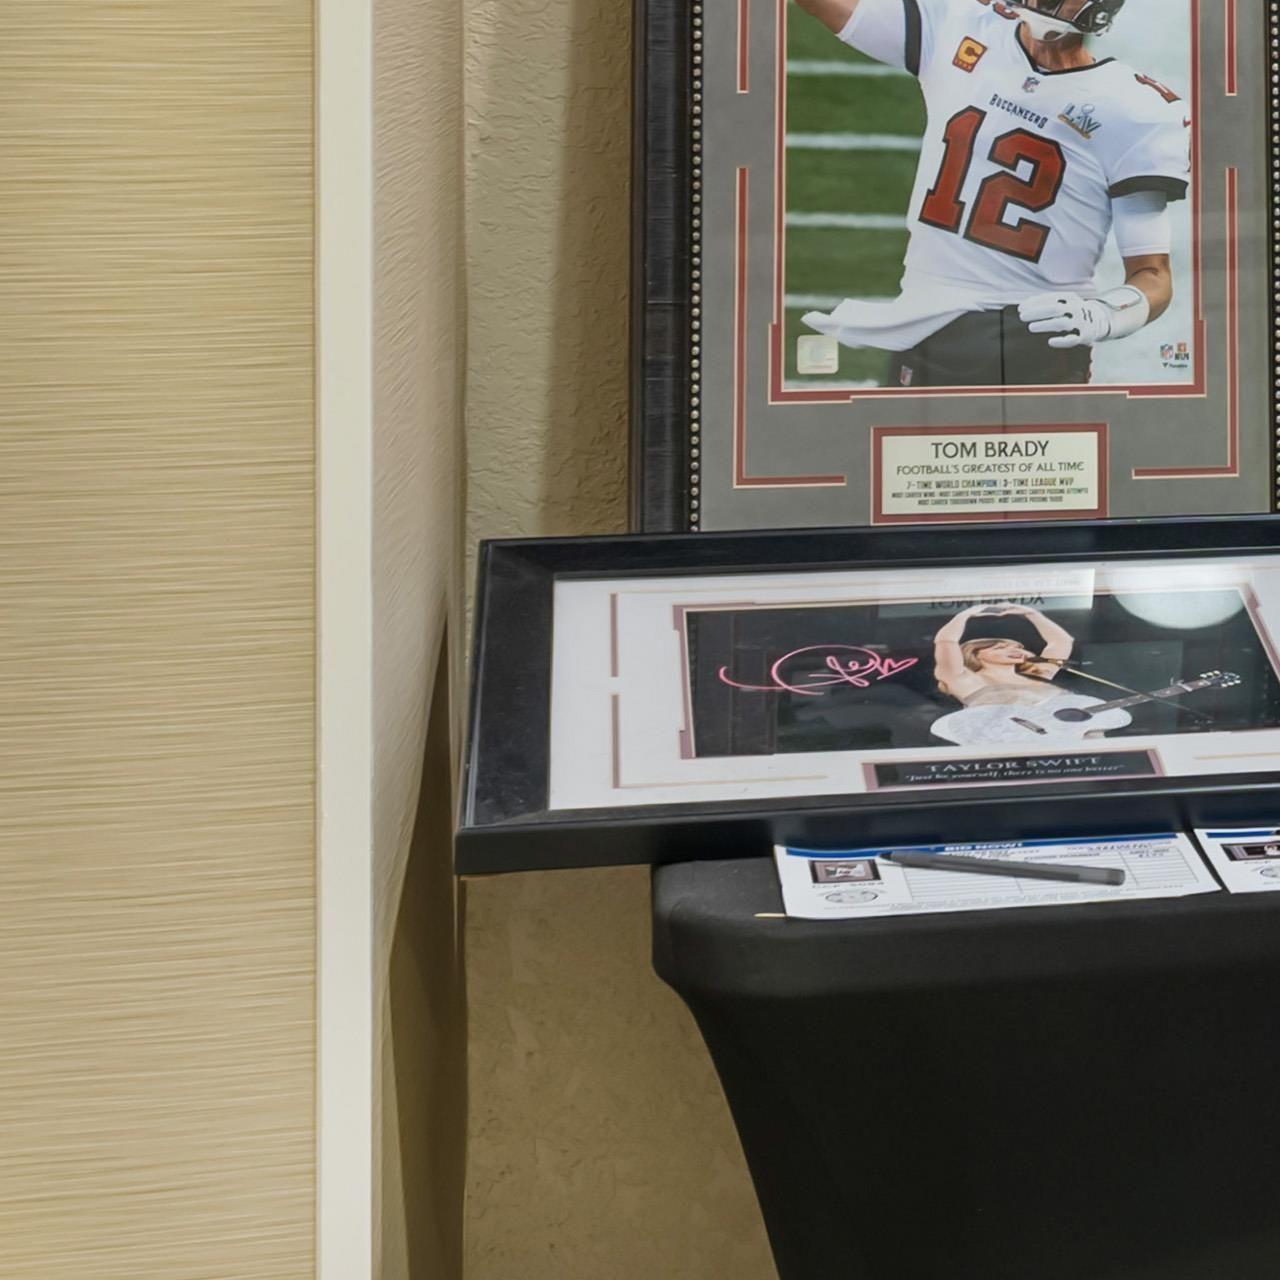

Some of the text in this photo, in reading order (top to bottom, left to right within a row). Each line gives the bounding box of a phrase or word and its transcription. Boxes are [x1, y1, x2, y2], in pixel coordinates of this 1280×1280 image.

[988, 93, 1049, 130] BUCCANEERS
[918, 105, 1066, 263] 12
[931, 440, 1049, 459] TOM BRADY
[897, 461, 1084, 476] FOOTBALL'S GREATEST OF ALL TIME
[926, 756, 1102, 772] TAYLOR SWIFT
[943, 844, 972, 852] BID
